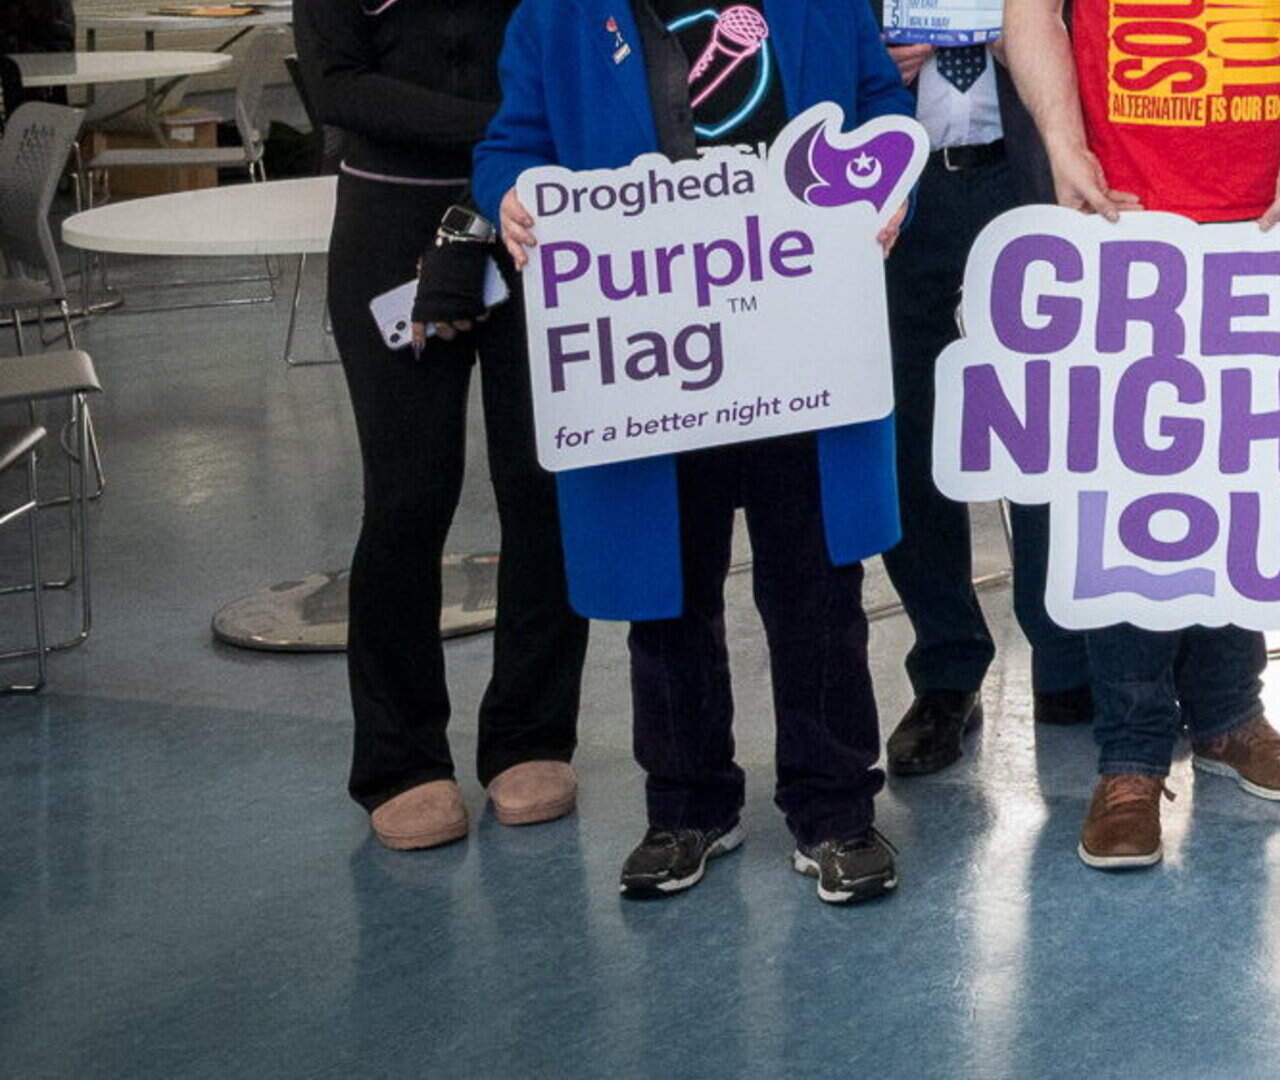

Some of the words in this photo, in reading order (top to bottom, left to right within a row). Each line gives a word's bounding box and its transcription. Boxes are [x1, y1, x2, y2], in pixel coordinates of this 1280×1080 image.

[1112, 93, 1204, 122] ALTERNATIVE
[1211, 95, 1227, 123] IS
[1231, 95, 1262, 122] OUR
[535, 162, 755, 217] Drogheda
[540, 216, 815, 308] Purple
[547, 316, 725, 393] Flag
[727, 295, 758, 314] TM
[554, 427, 593, 449] for
[602, 425, 617, 441] a
[625, 409, 708, 438] better
[715, 398, 781, 427] night
[788, 388, 831, 412] out
